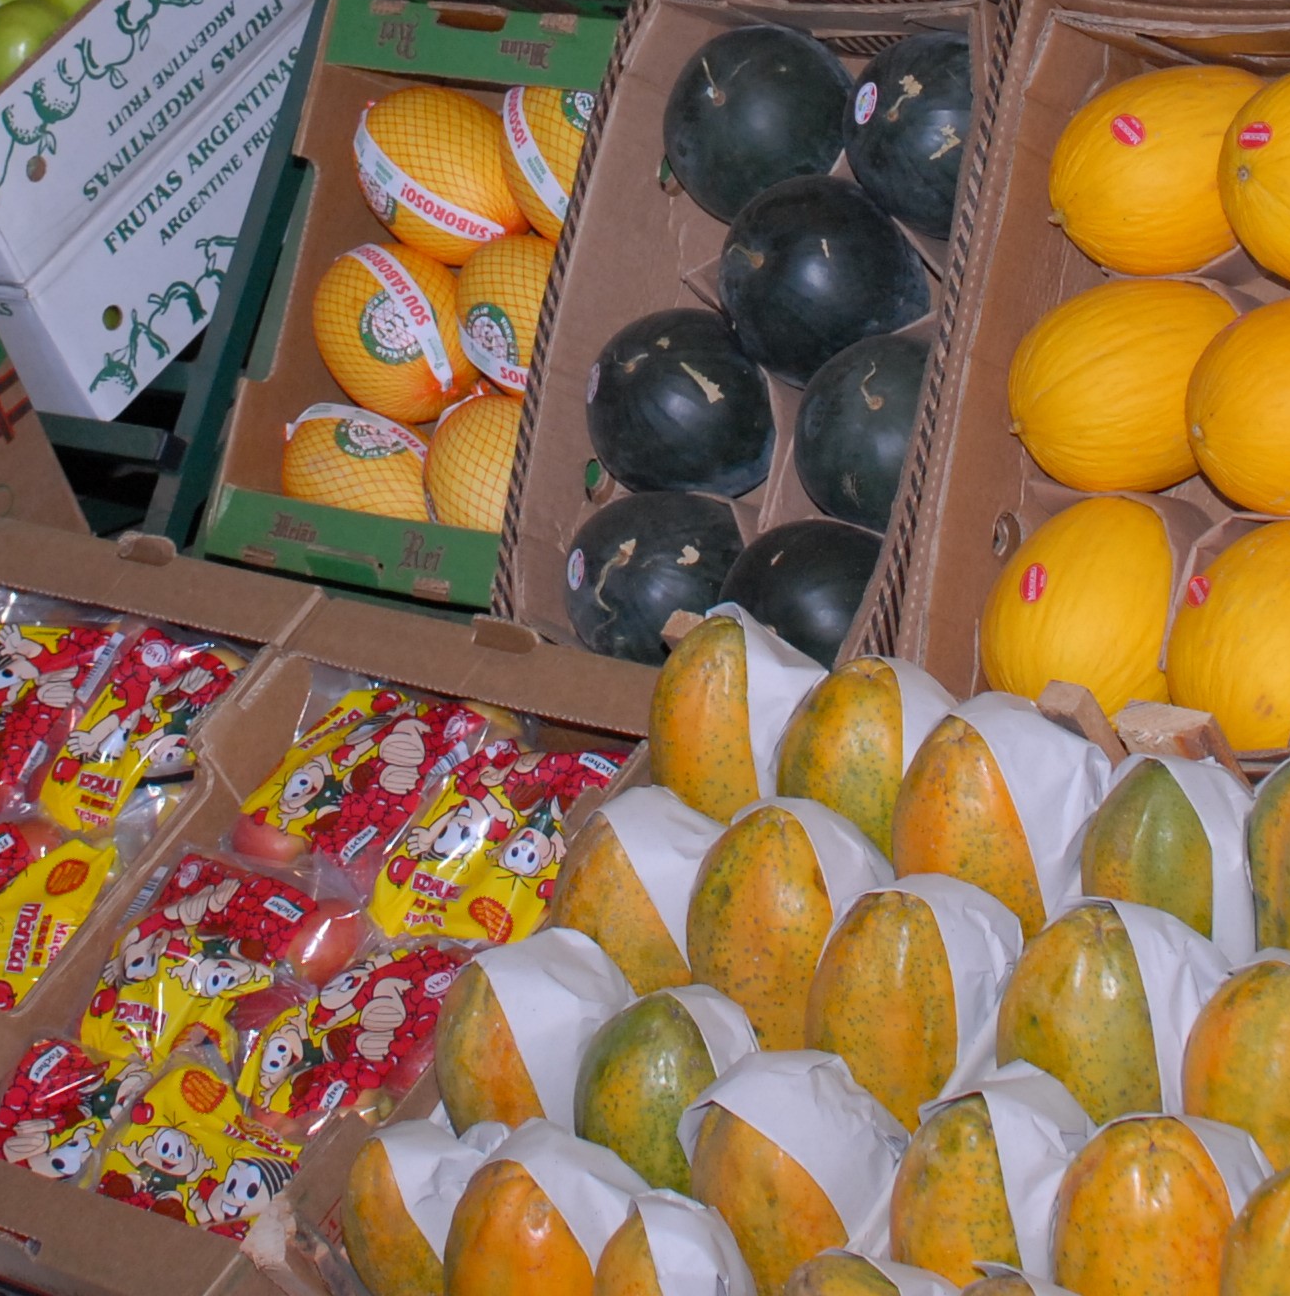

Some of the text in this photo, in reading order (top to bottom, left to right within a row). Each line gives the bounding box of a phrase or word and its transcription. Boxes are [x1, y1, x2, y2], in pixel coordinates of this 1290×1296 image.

[106, 0, 236, 137] ARGENTINE FRUIT
[82, 69, 207, 202] ARGENTINAS
[102, 45, 301, 255] FRUTAS ARGENTINAS
[158, 153, 244, 246] ARGENTINE
[400, 182, 489, 240] SABOROSO!
[402, 294, 432, 328] SOU
[5, 902, 43, 975] mônica
